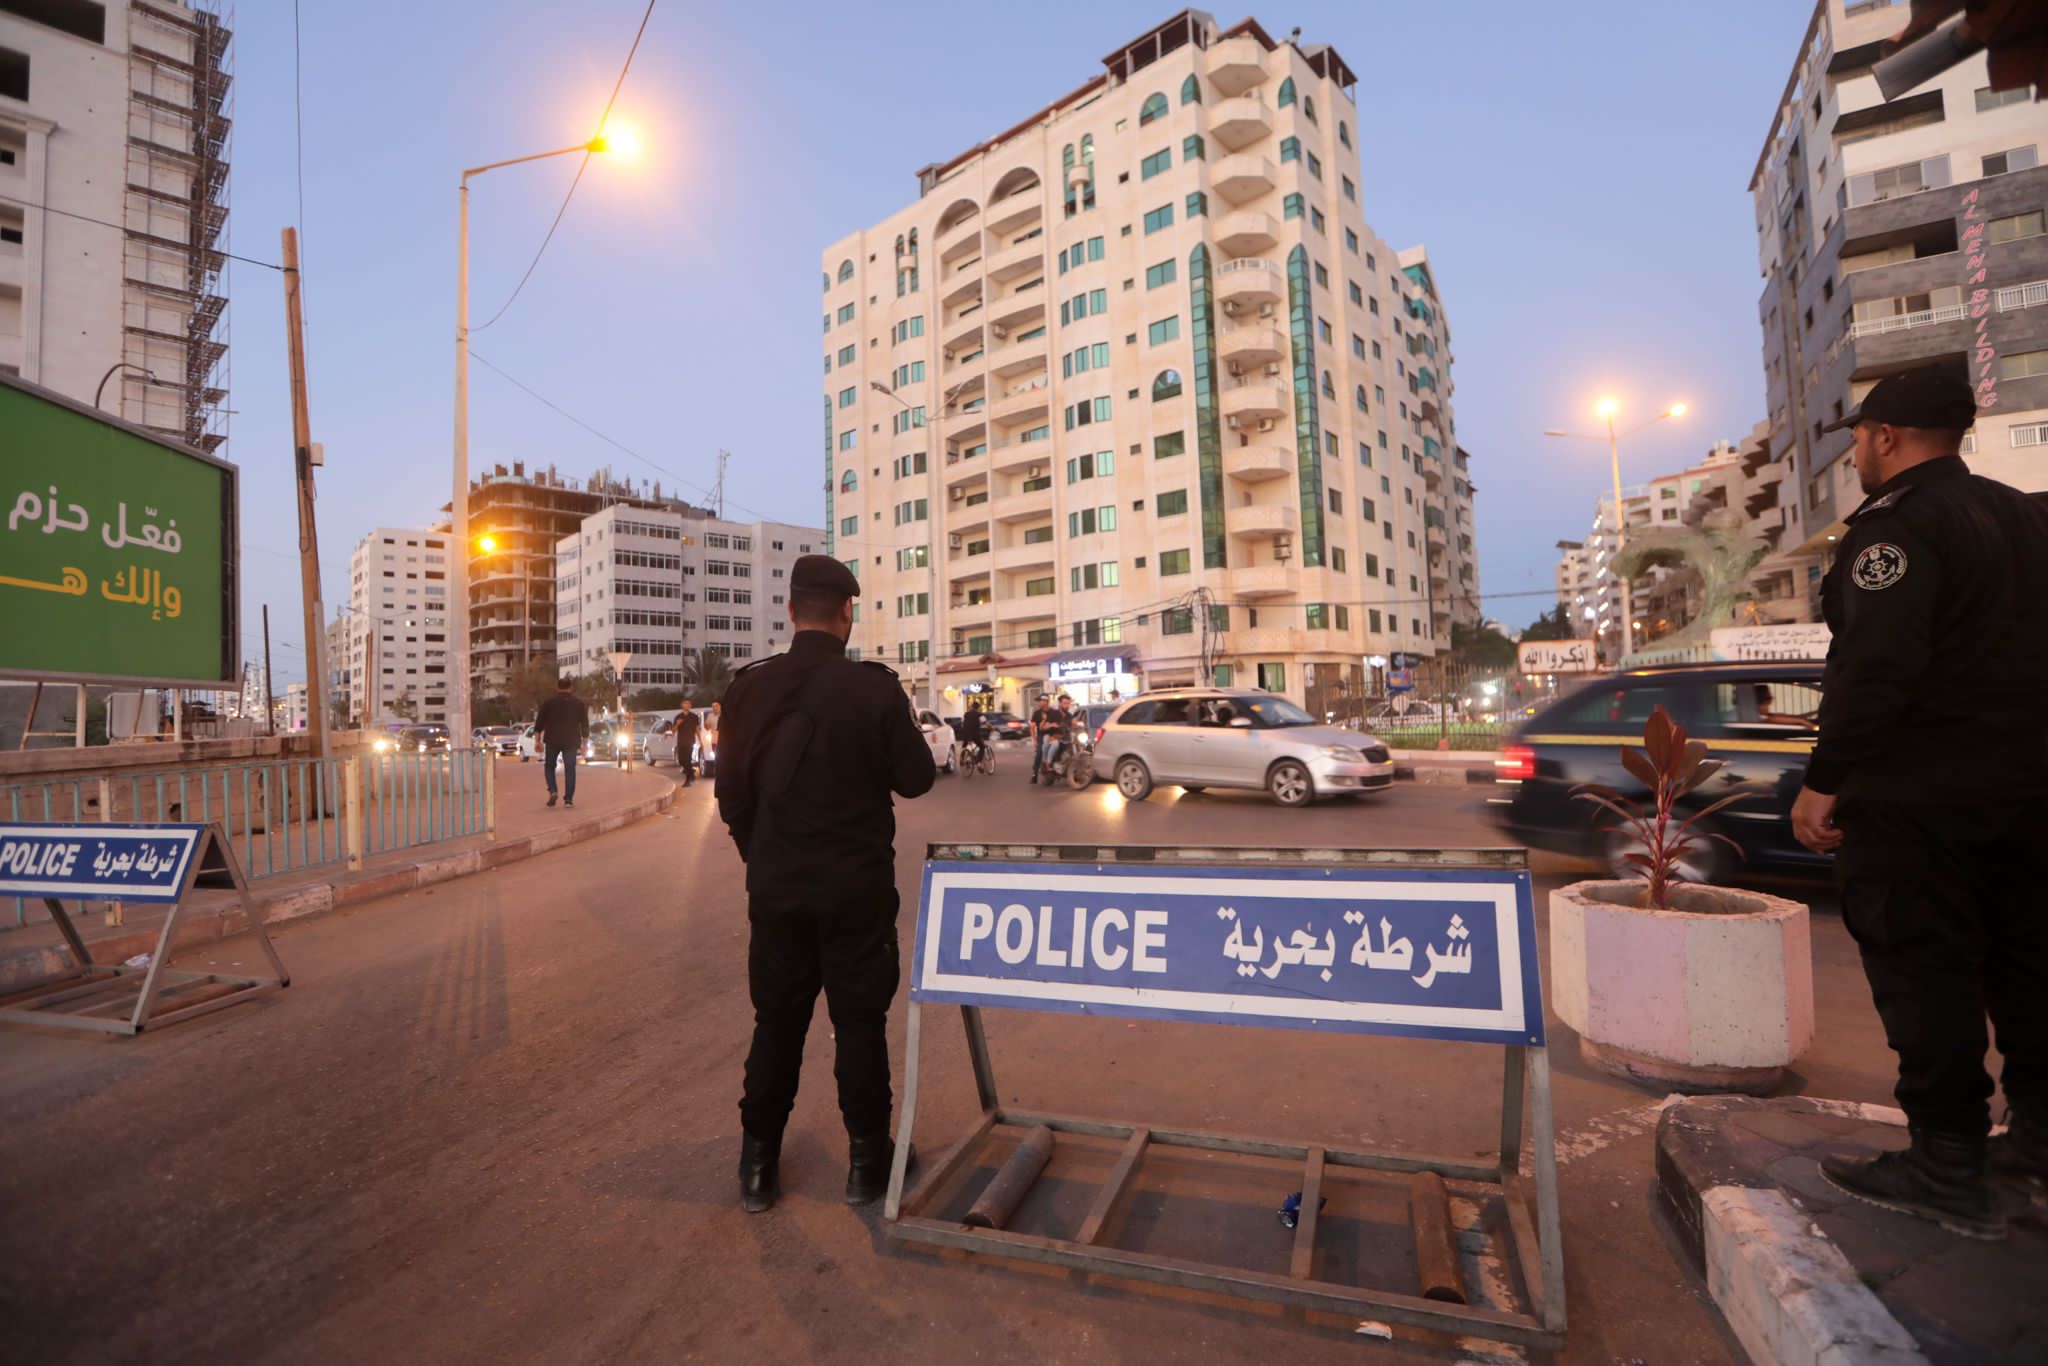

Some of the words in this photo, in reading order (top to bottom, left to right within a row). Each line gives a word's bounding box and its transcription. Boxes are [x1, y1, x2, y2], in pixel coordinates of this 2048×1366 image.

[1961, 188, 1980, 220] AL
[1961, 222, 1986, 284] MENA
[1969, 288, 1998, 408] BUILDING
[8, 485, 89, 534] حزم
[101, 565, 182, 620] وإلك
[1525, 648, 1543, 664] الله
[0, 841, 81, 876] POLICE
[93, 841, 136, 877] بحرية
[136, 843, 178, 879] شرطة
[959, 902, 1169, 974] POLICE
[1216, 905, 1336, 983] بحرية
[1343, 910, 1472, 989] شرطة
